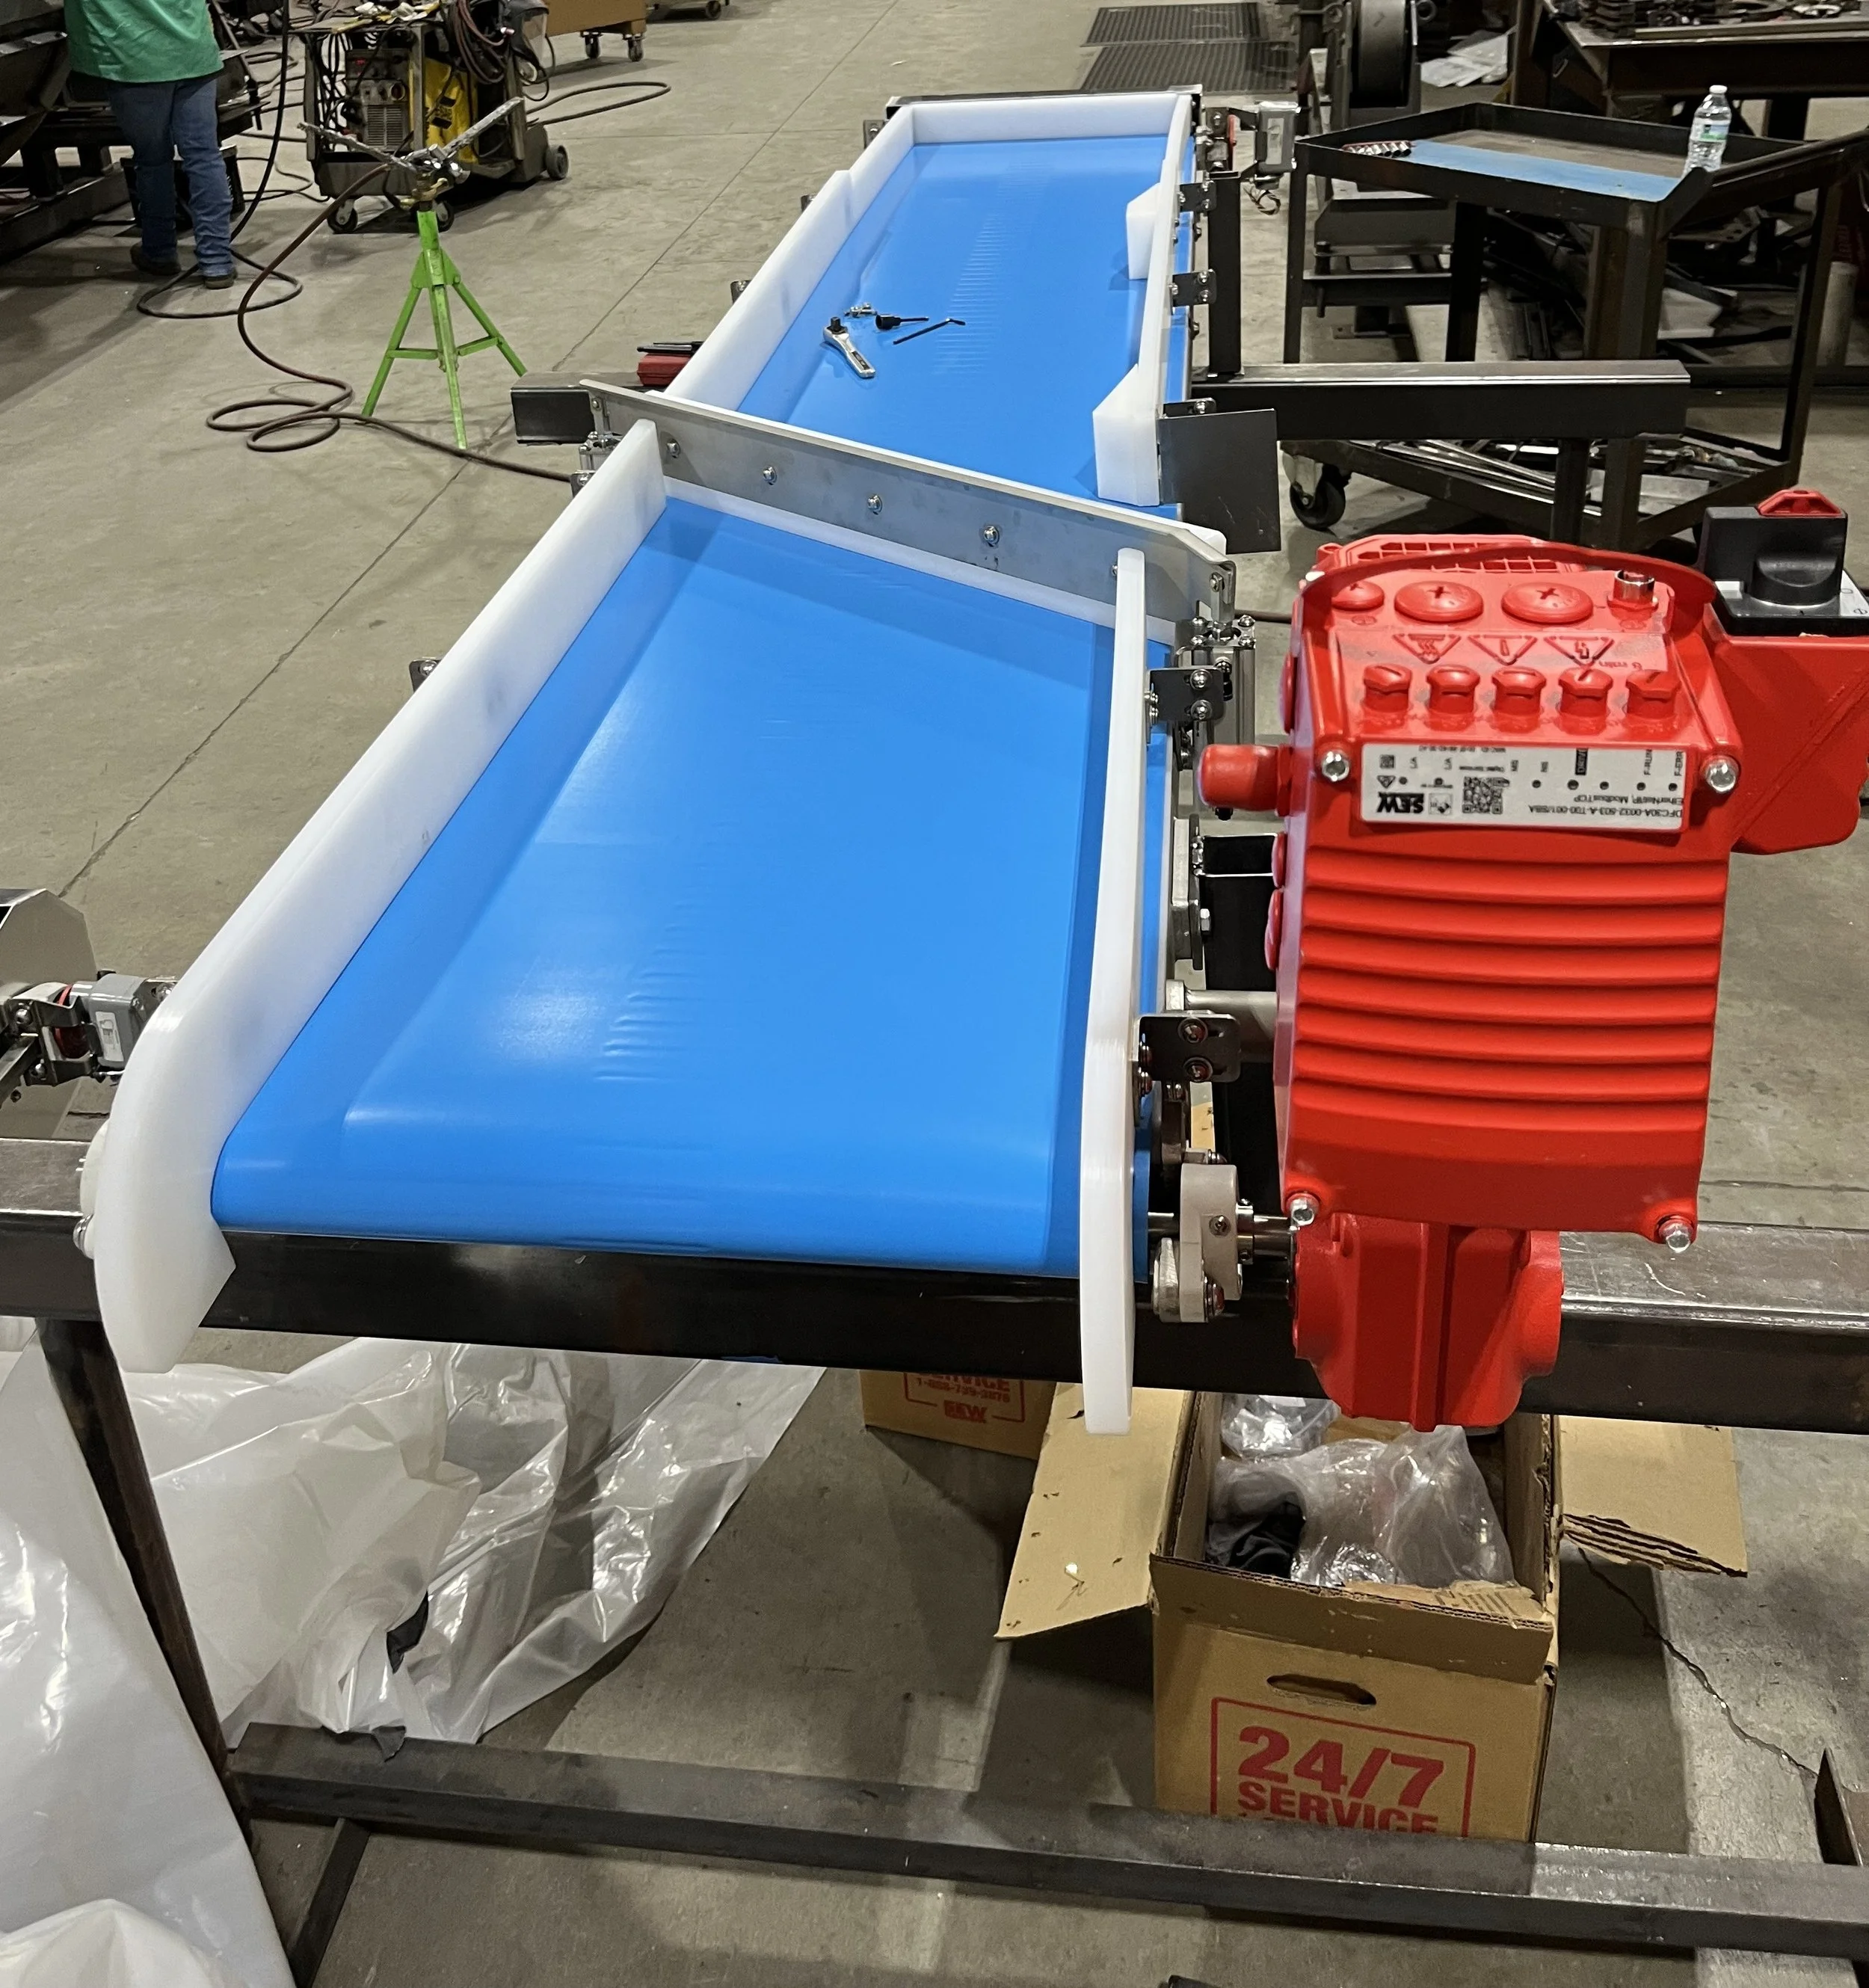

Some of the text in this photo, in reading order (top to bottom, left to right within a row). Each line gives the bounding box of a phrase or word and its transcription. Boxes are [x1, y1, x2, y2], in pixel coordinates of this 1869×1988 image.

[1376, 793, 1424, 813] SEW
[1238, 1726, 1444, 1809] 24/7
[1238, 1781, 1439, 1832] SERVICE
